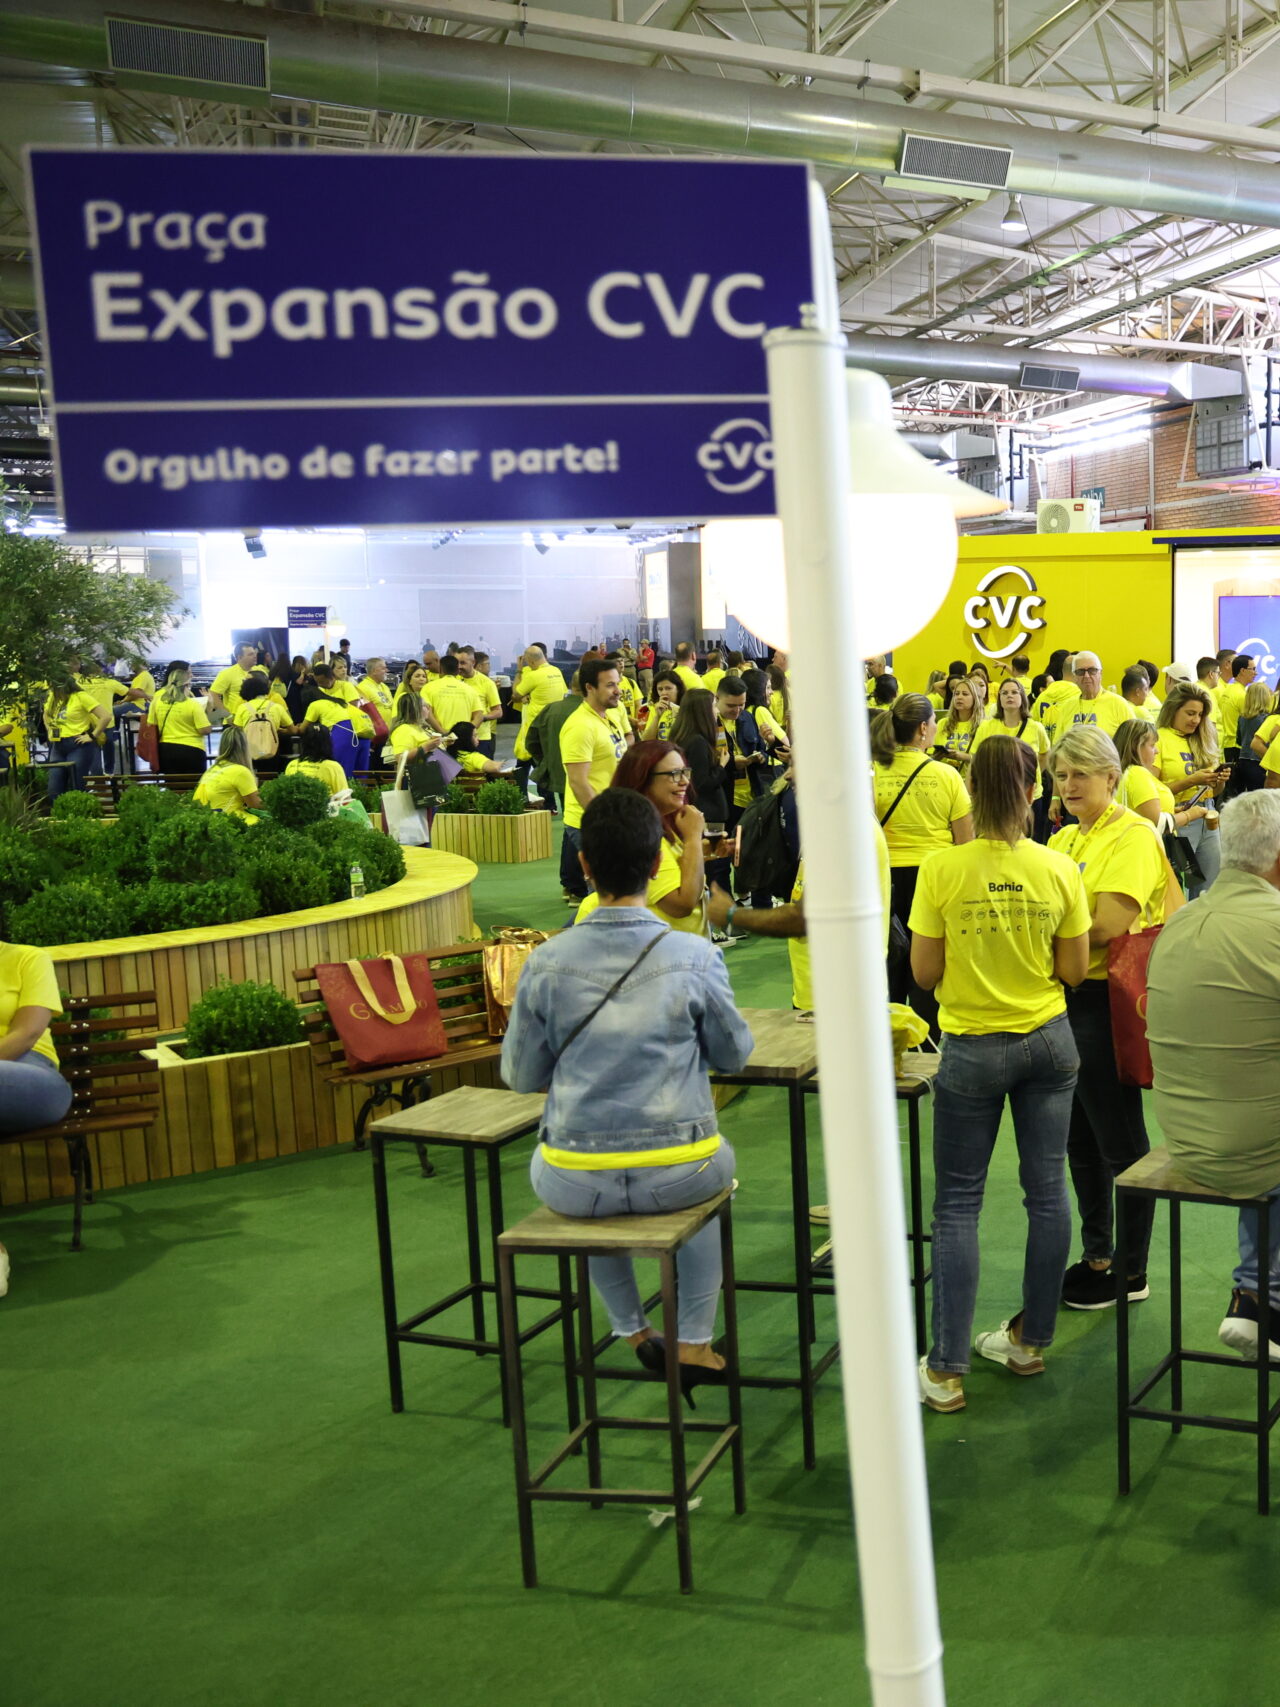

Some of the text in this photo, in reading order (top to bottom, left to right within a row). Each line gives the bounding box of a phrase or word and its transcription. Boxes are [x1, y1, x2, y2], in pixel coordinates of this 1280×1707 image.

[84, 199, 267, 263] Praça
[91, 271, 766, 358] Expansão CVC
[104, 440, 619, 490] Orgulho de fazer parte!
[964, 595, 1046, 629] CVC
[988, 882, 1023, 892] Bahia
